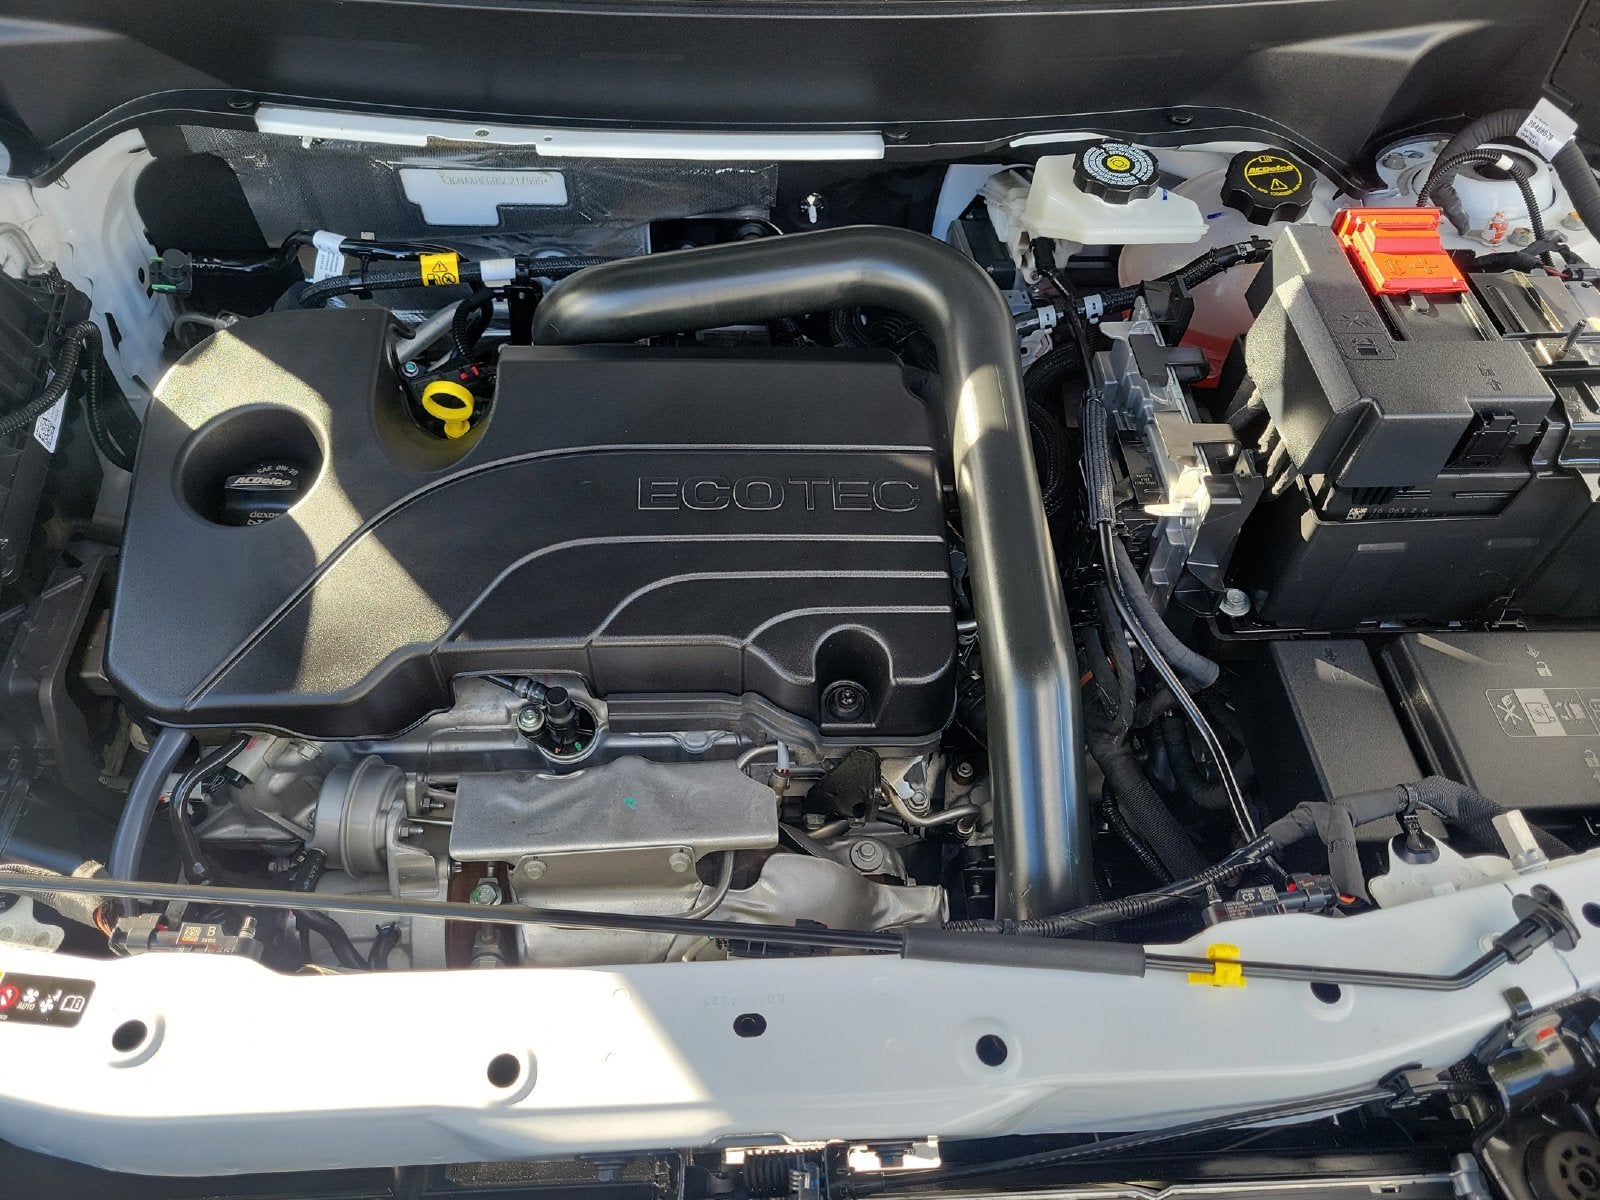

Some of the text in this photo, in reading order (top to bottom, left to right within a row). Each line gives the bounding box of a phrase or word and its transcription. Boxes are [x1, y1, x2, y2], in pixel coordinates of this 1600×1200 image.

[1248, 165, 1294, 176] ACDelco
[230, 476, 292, 487] ACDelco
[637, 477, 920, 512] ECOTEC
[1242, 892, 1255, 902] CB
[207, 926, 217, 937] B
[16, 1002, 35, 1011] AUTO
